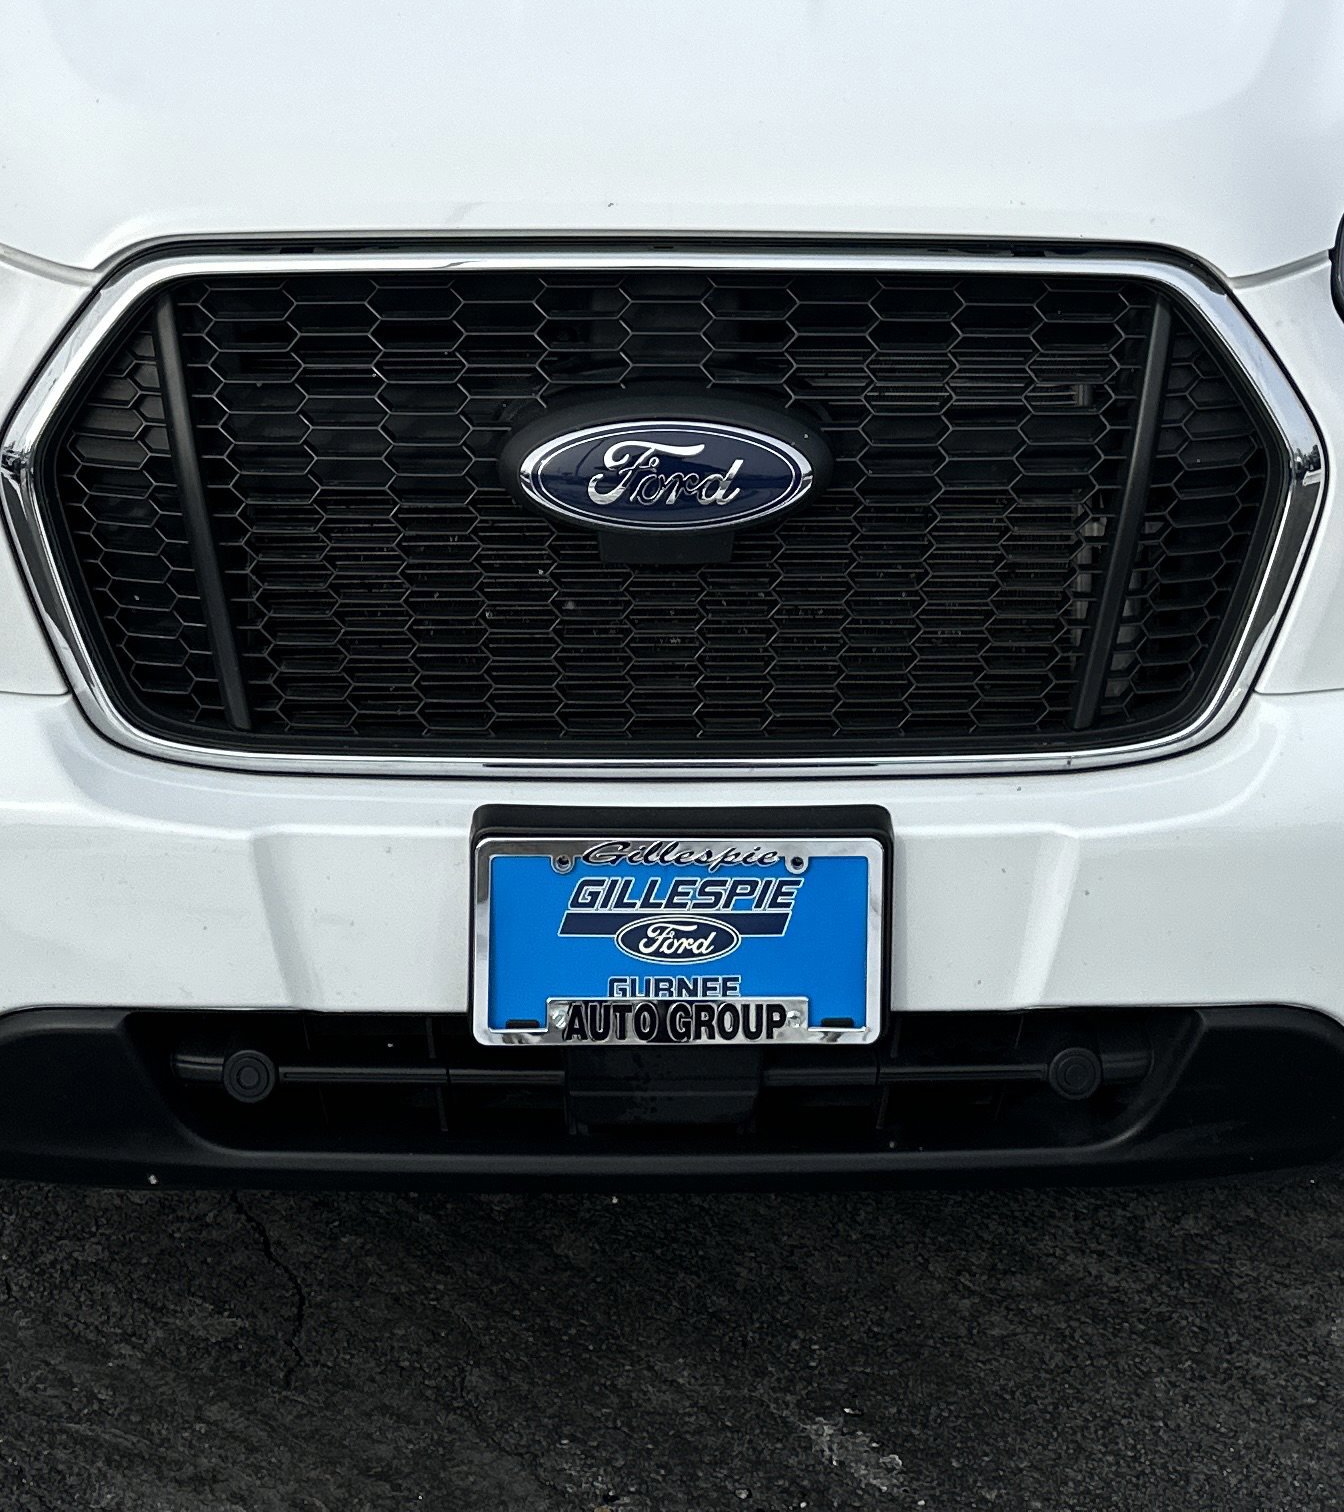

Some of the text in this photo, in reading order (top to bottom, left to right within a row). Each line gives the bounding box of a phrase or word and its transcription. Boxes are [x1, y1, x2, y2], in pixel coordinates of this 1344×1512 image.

[587, 439, 744, 506] Ford
[581, 840, 781, 873] Gillespie
[567, 876, 805, 912] GILLESPIE
[637, 922, 717, 955] Ford
[607, 974, 742, 998] GURNEE
[562, 1001, 787, 1043] AUTO GROUP
